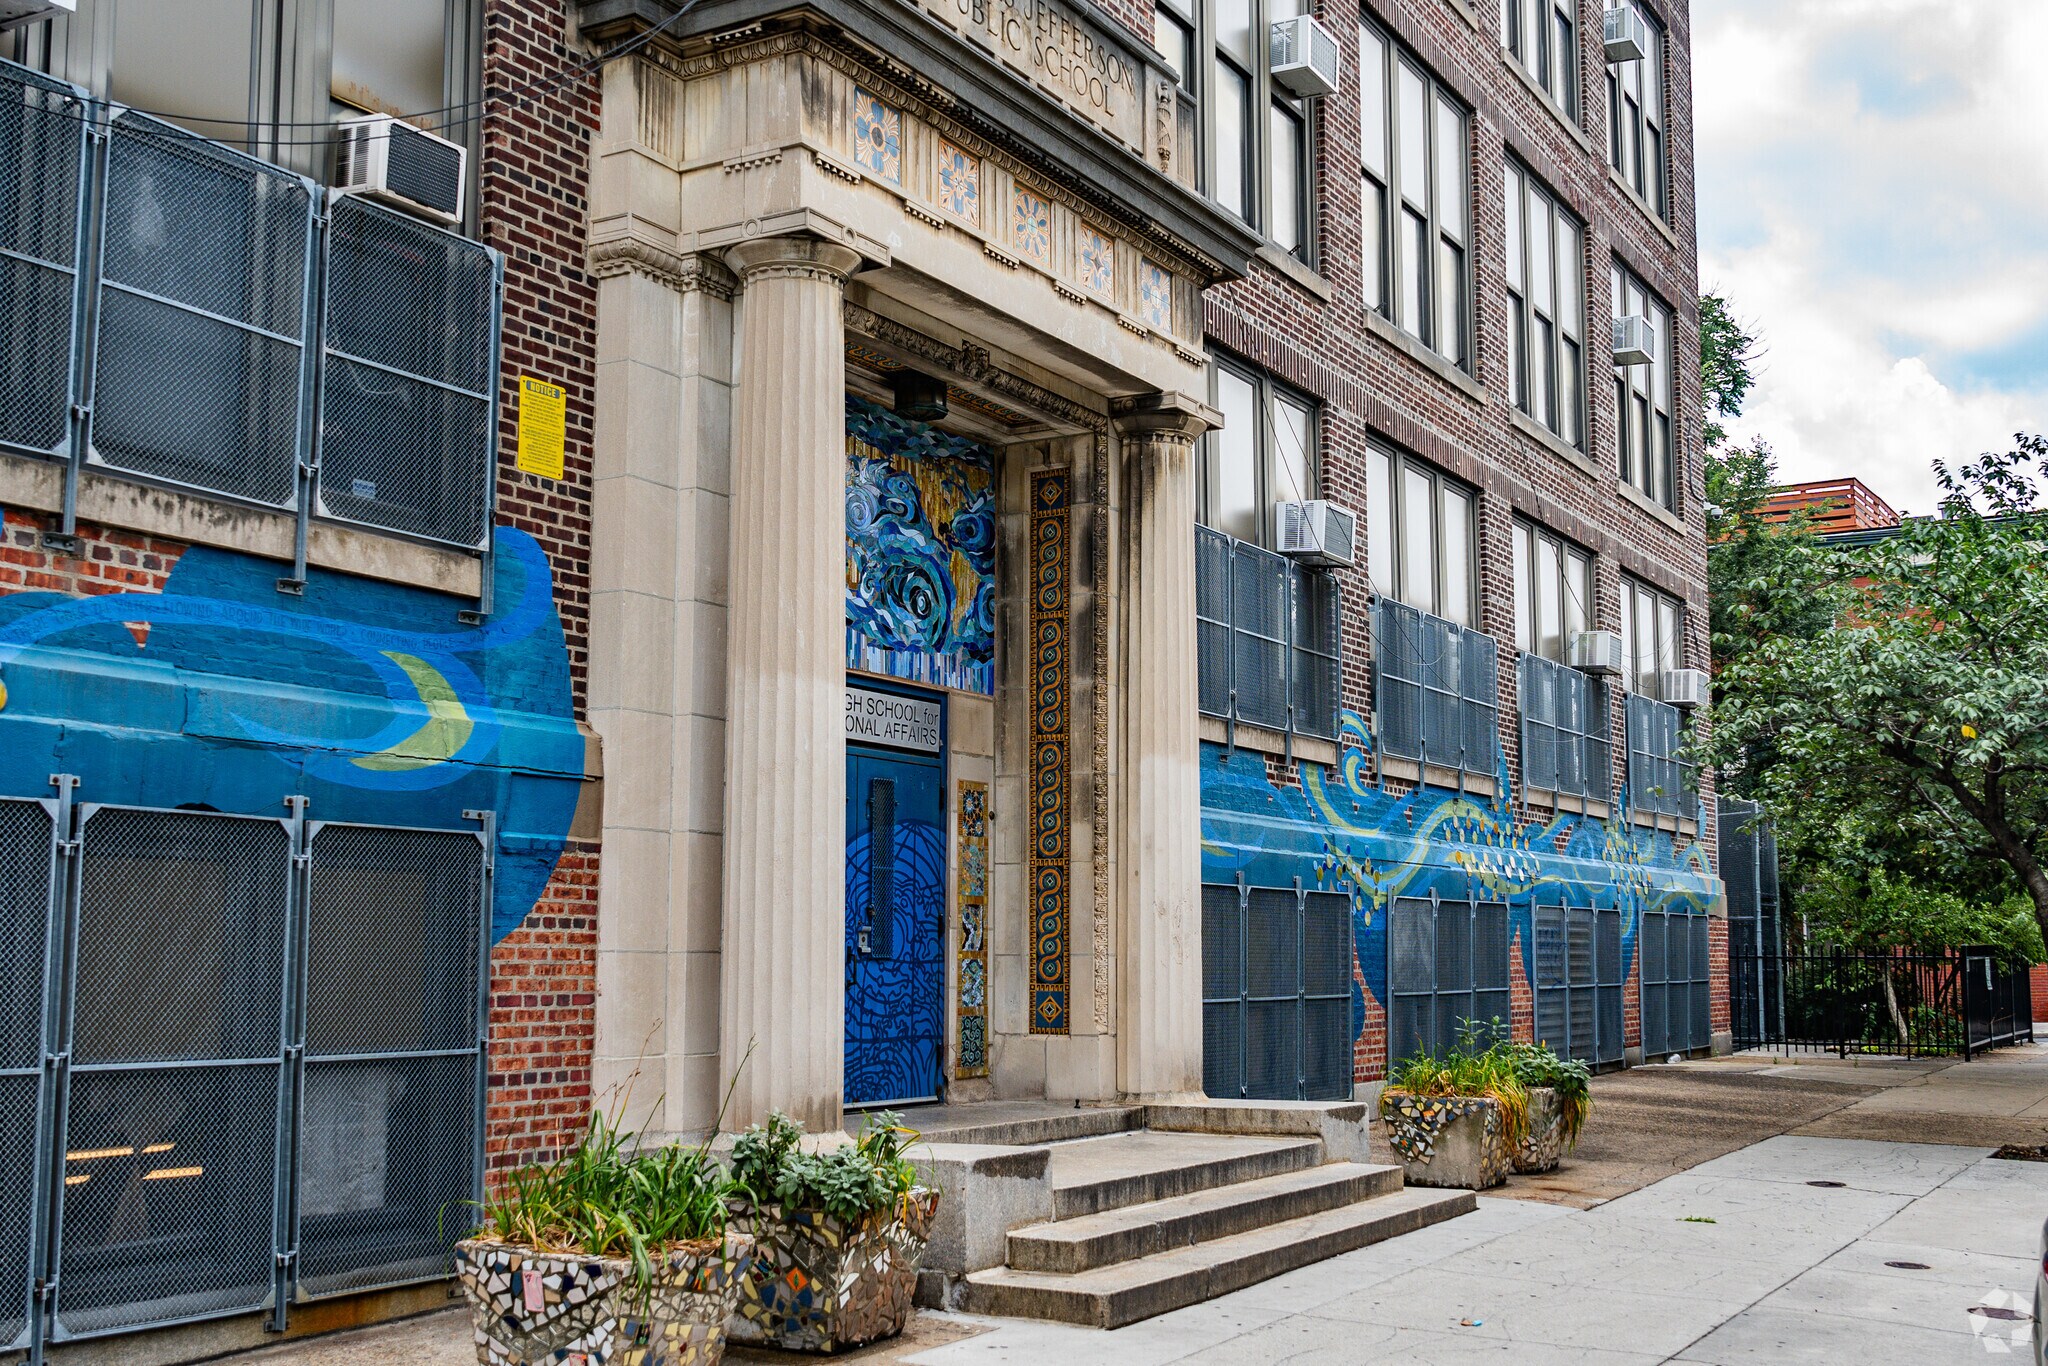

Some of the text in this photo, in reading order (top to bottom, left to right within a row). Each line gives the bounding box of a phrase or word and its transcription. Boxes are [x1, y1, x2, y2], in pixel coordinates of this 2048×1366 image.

[1023, 0, 1136, 98] JEFFERSON
[1033, 36, 1116, 117] SCHOOL
[530, 381, 557, 398] NOTICE
[360, 629, 417, 650] CONNECTING
[866, 697, 920, 723] SCHOOL
[923, 708, 939, 726] for
[845, 714, 937, 746] ONAL AFFAIRS
